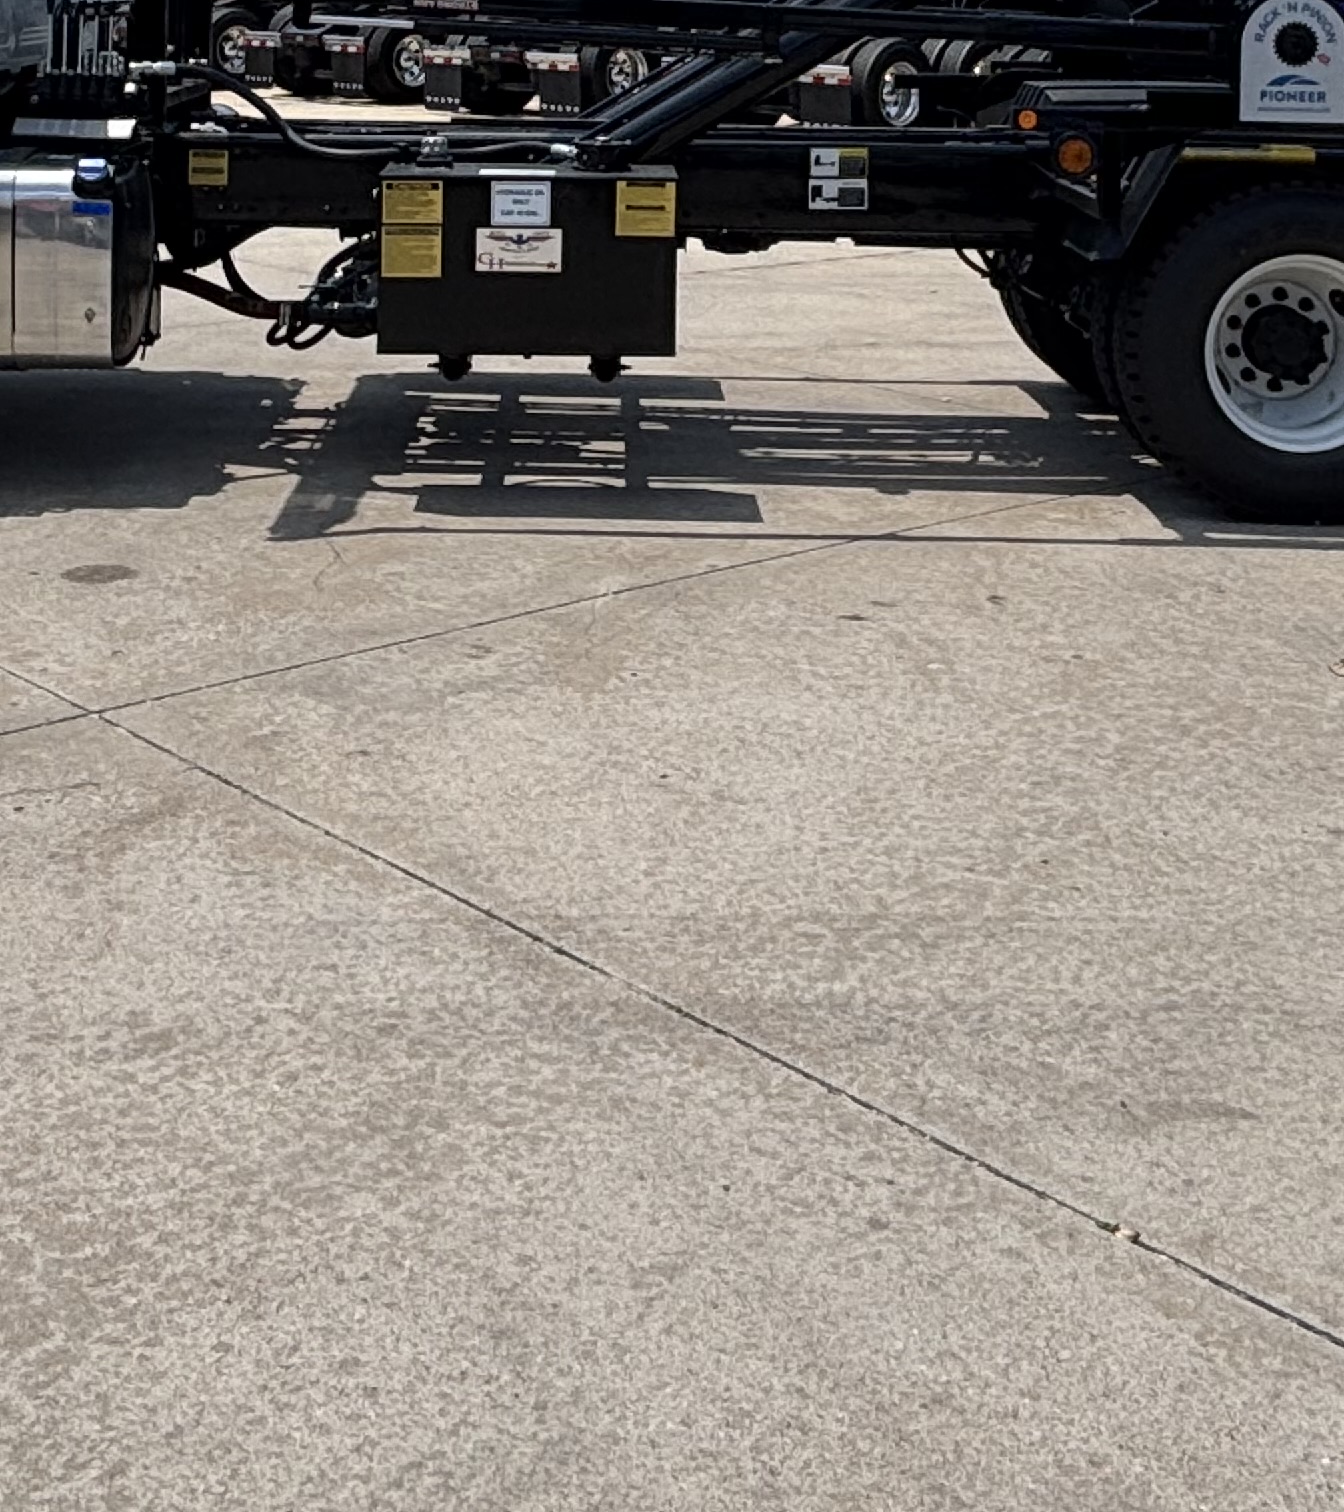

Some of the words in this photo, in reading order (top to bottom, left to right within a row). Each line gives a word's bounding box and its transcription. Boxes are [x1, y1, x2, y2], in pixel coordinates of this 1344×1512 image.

[1254, 7, 1283, 43] RACK
[1300, 2, 1337, 44] PINION
[1260, 90, 1328, 104] PIONEER
